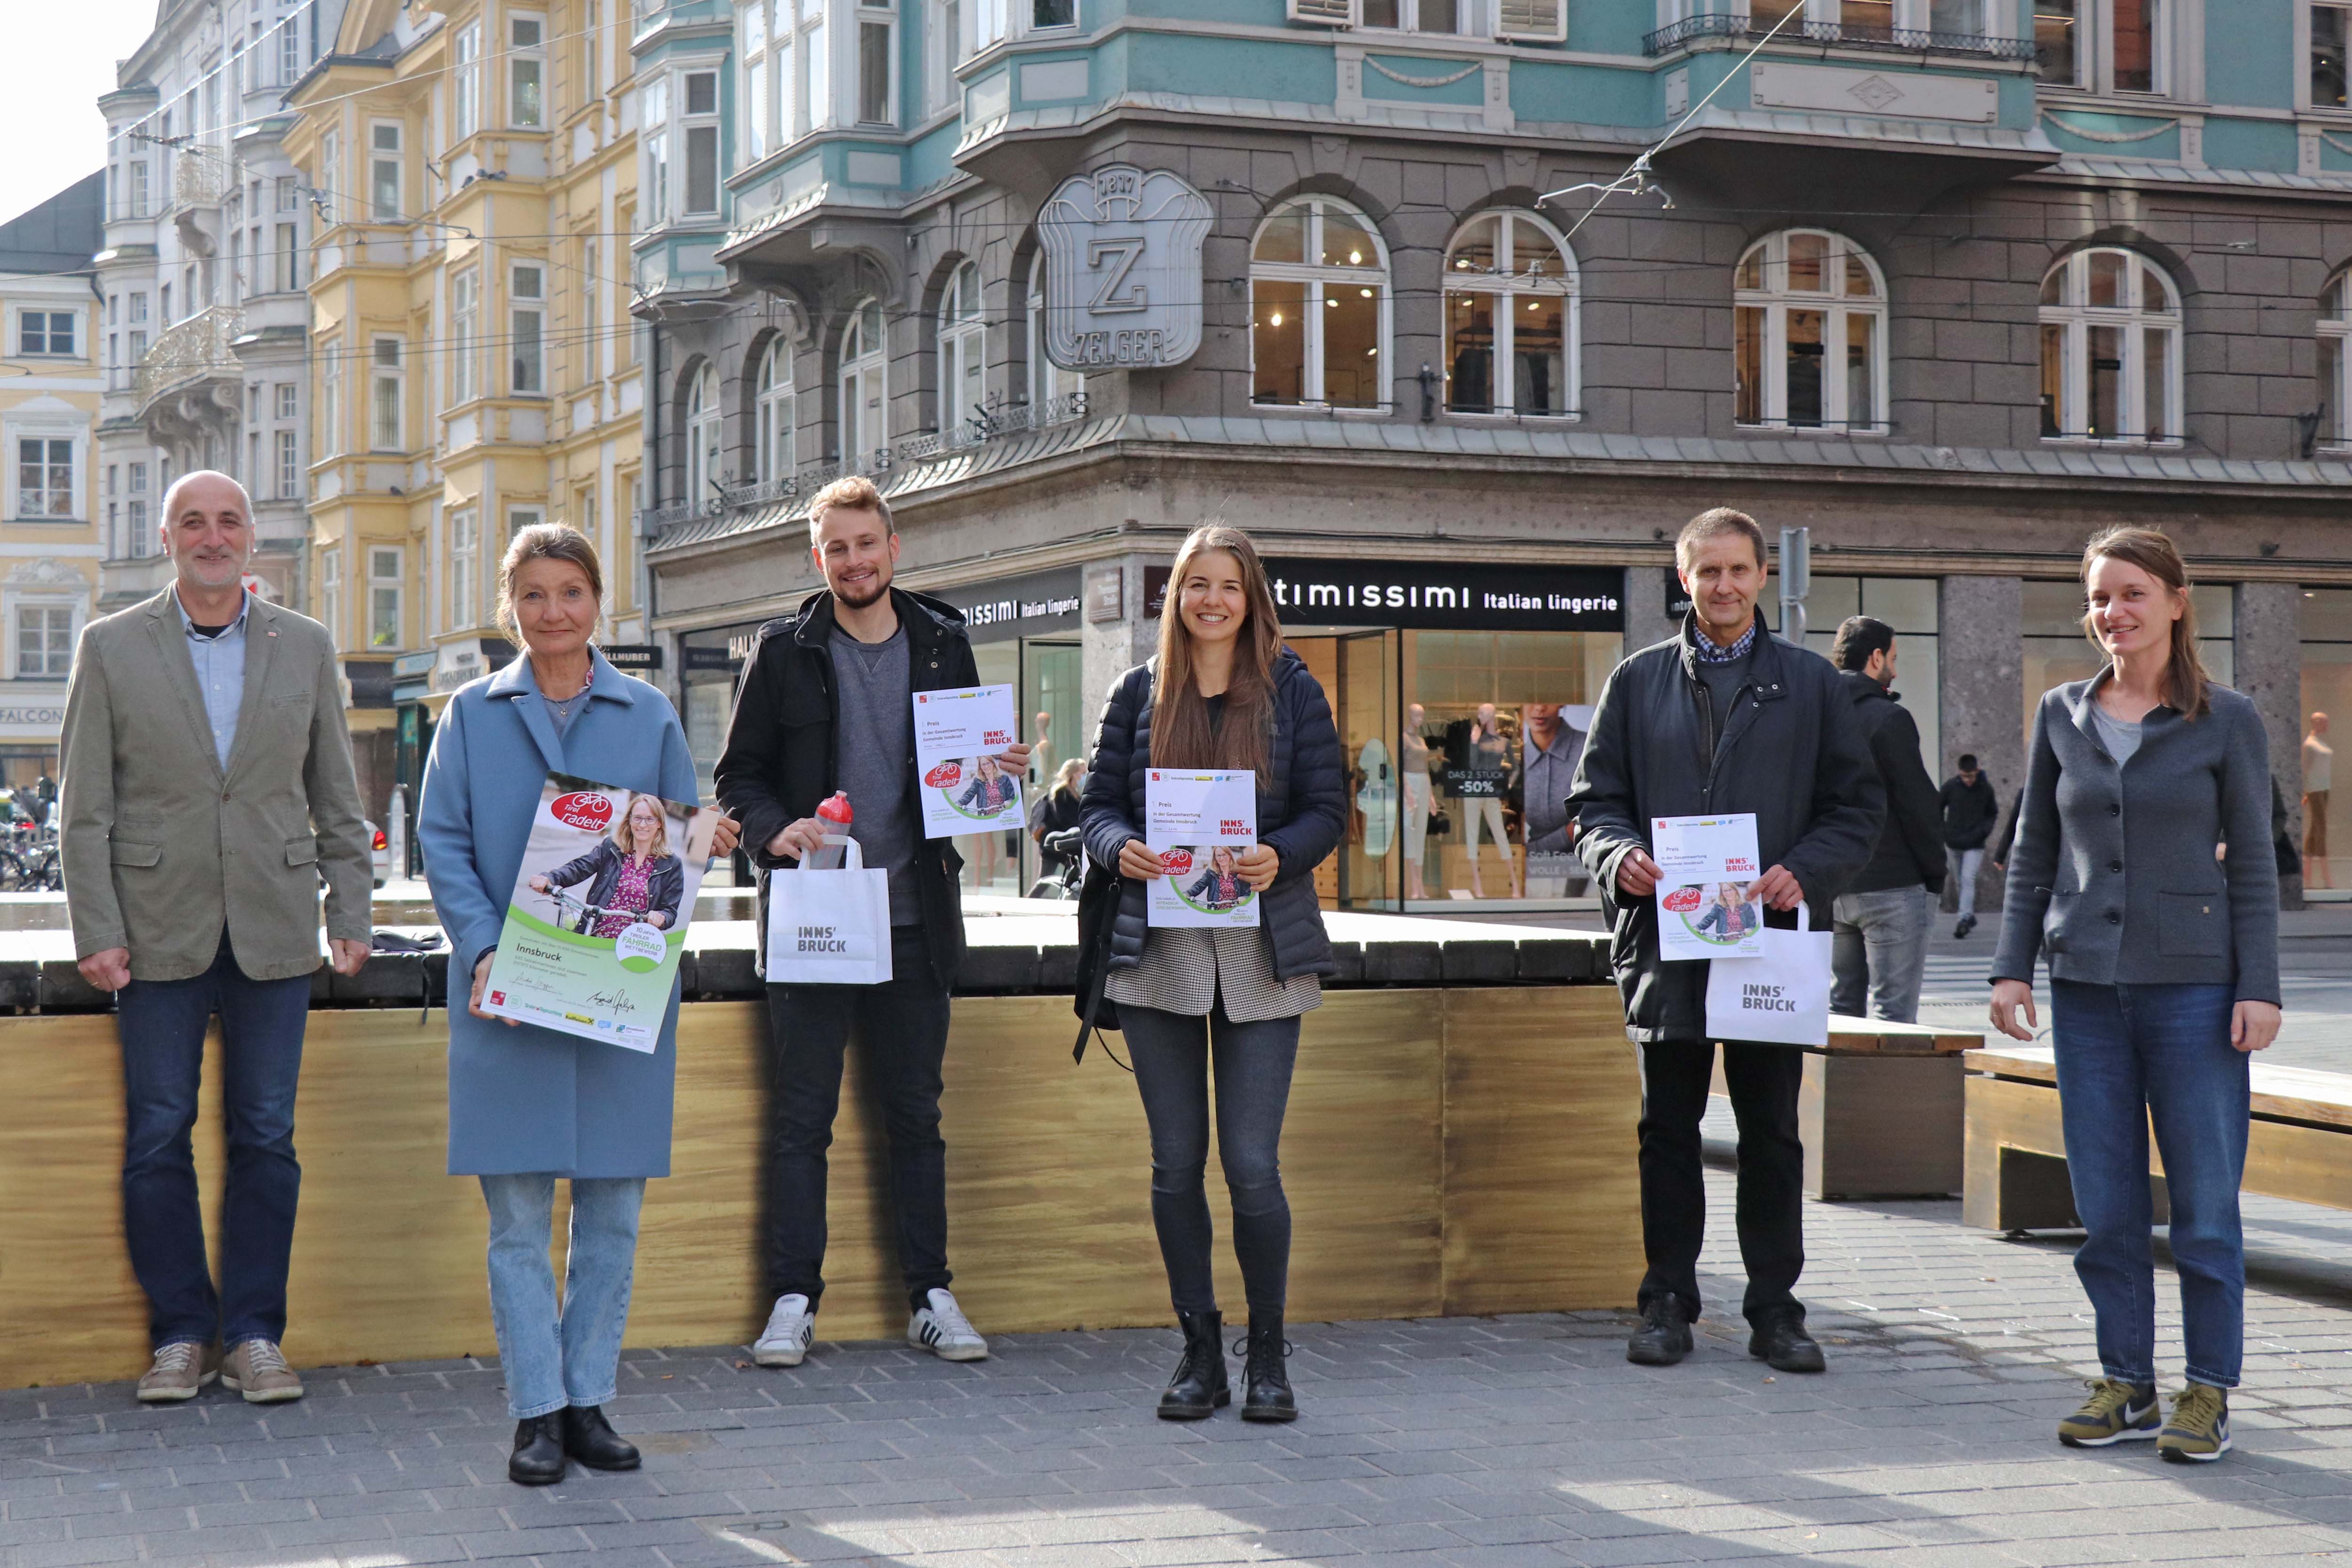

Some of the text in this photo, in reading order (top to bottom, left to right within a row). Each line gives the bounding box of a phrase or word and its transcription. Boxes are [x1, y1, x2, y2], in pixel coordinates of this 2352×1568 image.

[1099, 175, 1135, 195] 1817
[1088, 237, 1148, 314] Z
[1075, 330, 1165, 365] ZELGER
[1022, 602, 1046, 617] Italian
[1047, 596, 1079, 616] lingerie
[1484, 593, 1542, 611] Italian
[1548, 594, 1618, 613] lingerie
[984, 737, 1012, 745] BRUCK
[933, 777, 961, 788] radelt
[1458, 781, 1495, 793] -50%
[564, 804, 580, 813] Tirol
[561, 813, 607, 830] radelt
[1671, 902, 1700, 911] radelt
[622, 936, 662, 951] FAHRRAD
[630, 932, 650, 941] TIROLER
[516, 942, 562, 962] Innsbruck
[625, 944, 658, 956] WETTBEWERB
[798, 940, 847, 952] BRUCK
[1742, 996, 1796, 1012] BRUCK
